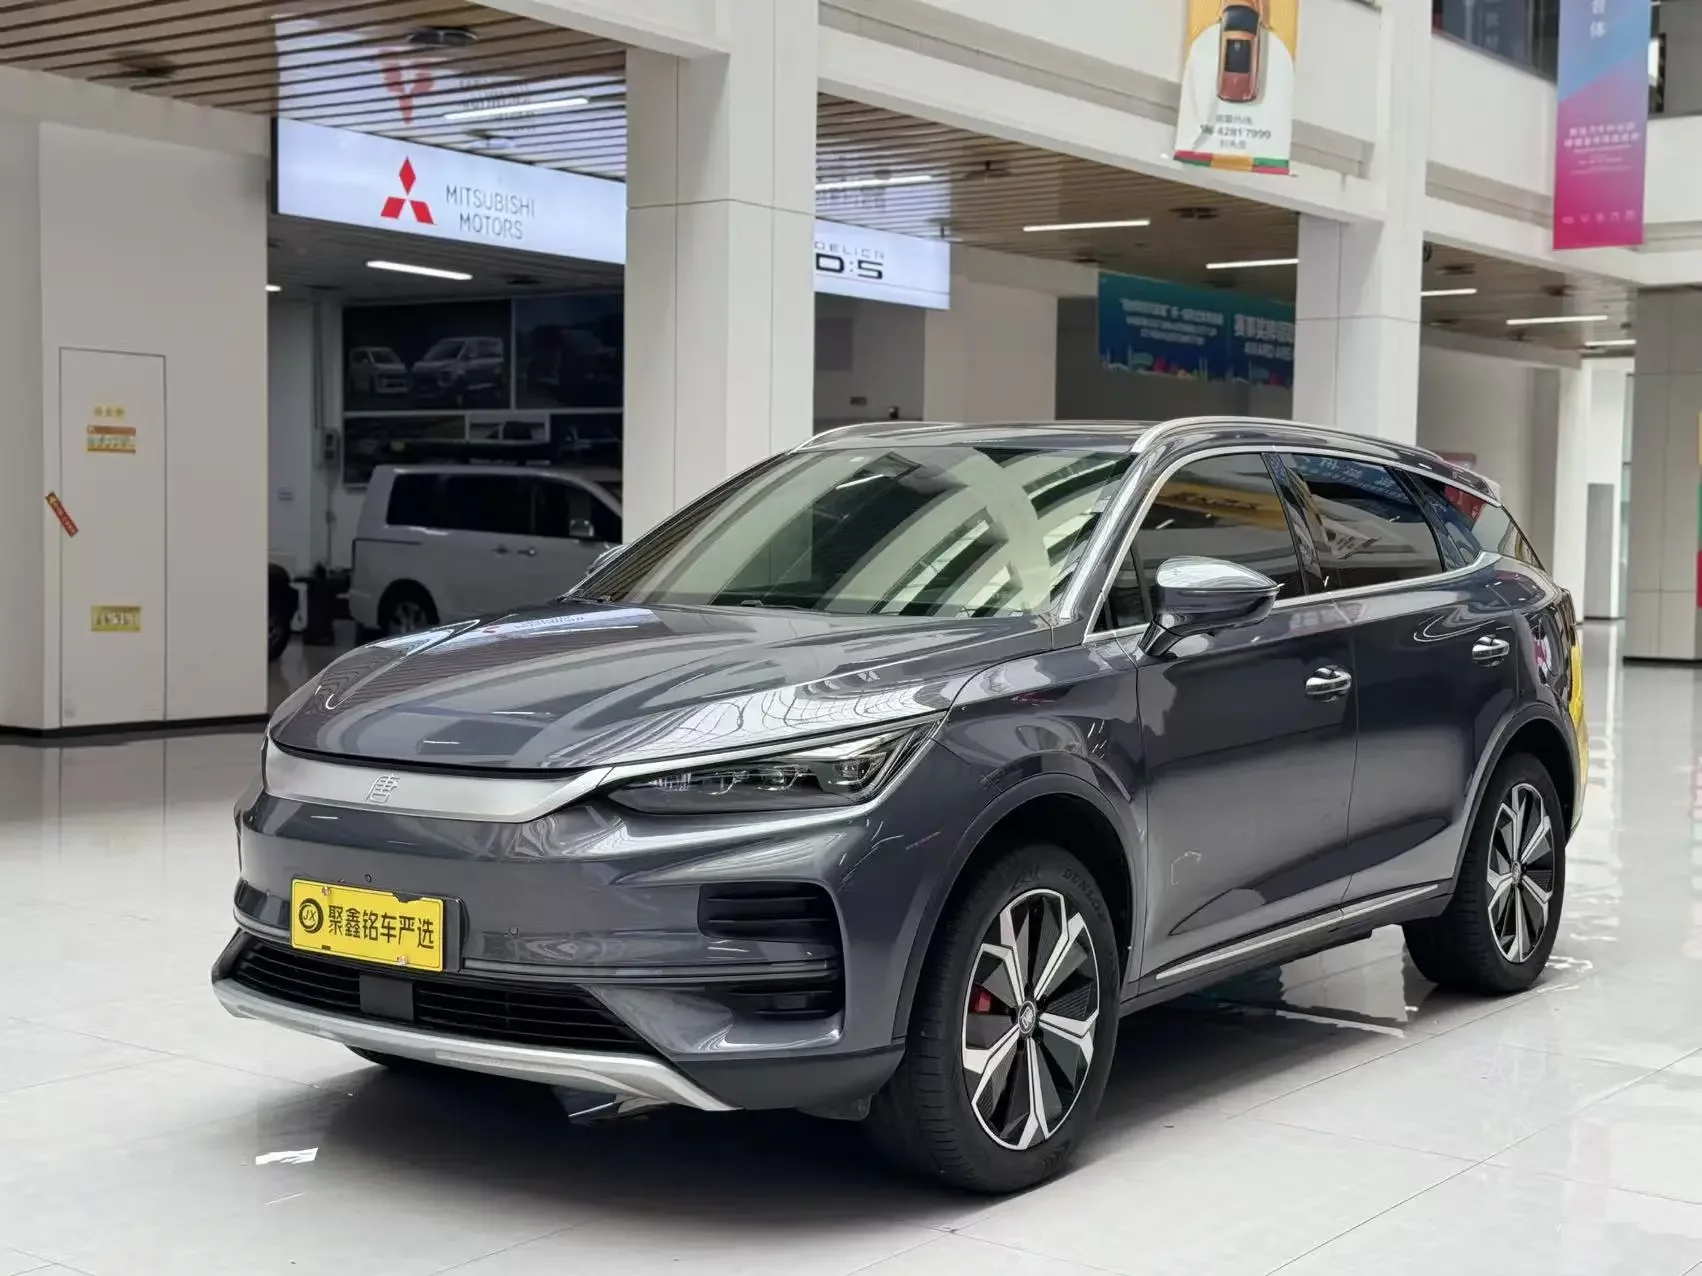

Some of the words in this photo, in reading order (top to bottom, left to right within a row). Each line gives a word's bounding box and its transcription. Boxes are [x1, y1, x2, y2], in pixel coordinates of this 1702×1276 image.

[446, 184, 535, 218] MITSUBISHI
[460, 212, 523, 240] MOTORS
[816, 253, 883, 280] D:5
[303, 910, 317, 923] JX
[328, 904, 434, 949] 聚鑫铭车严选
